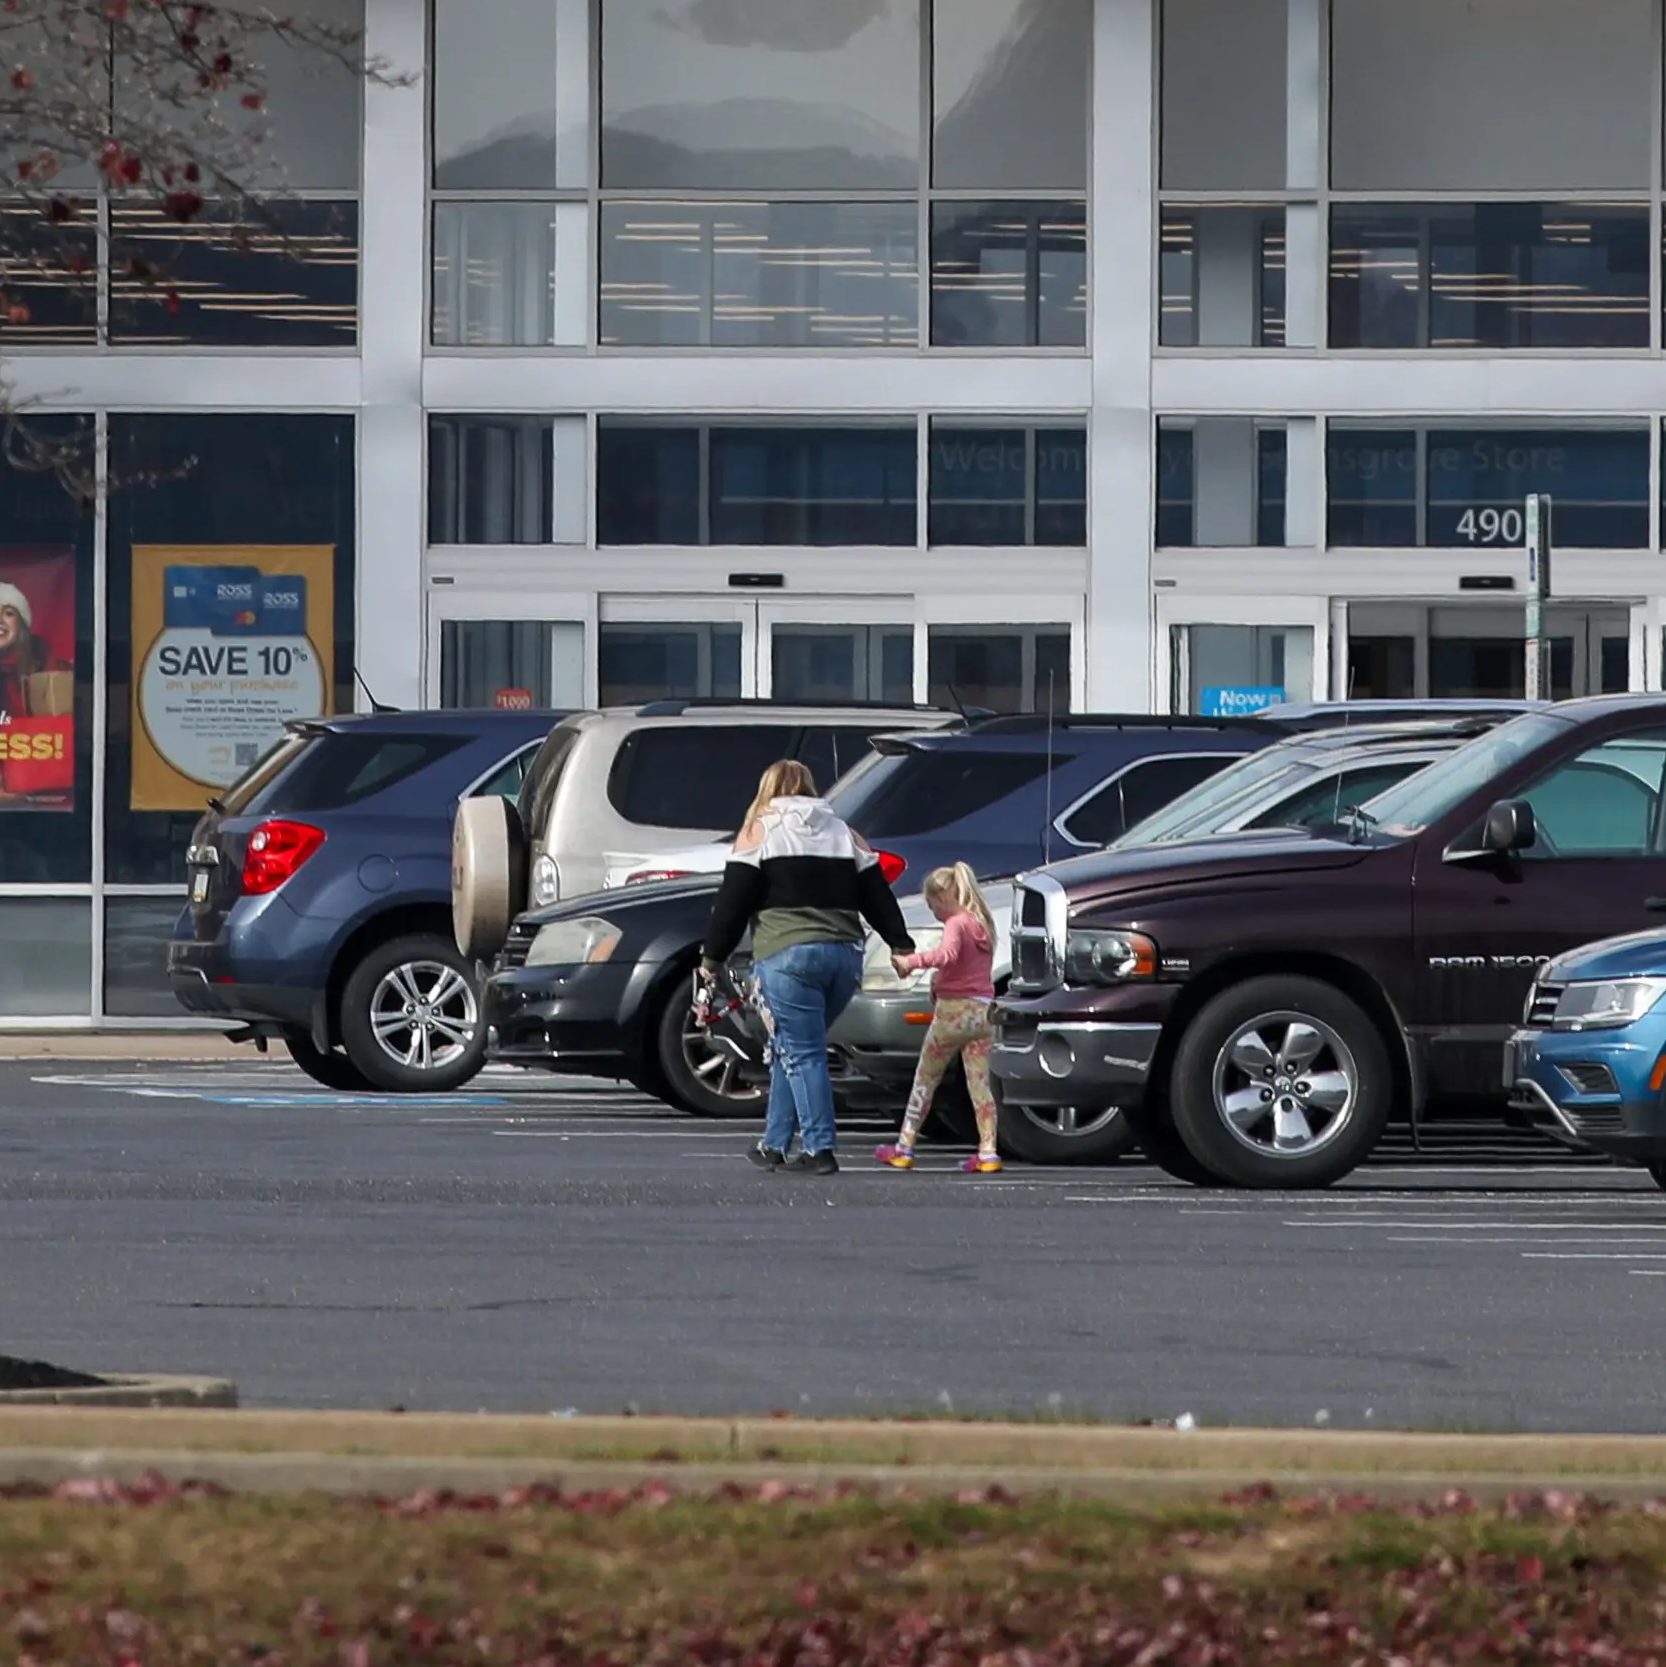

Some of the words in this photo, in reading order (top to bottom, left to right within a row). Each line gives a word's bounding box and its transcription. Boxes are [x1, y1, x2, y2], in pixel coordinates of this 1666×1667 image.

[939, 438, 1081, 472] Welcm
[1472, 439, 1568, 472] Store
[1455, 507, 1523, 543] 490
[216, 583, 253, 598] ROSS
[263, 592, 299, 606] ROSS
[158, 645, 248, 677] SAVE
[258, 645, 309, 677] 10%
[1219, 689, 1266, 706] Now
